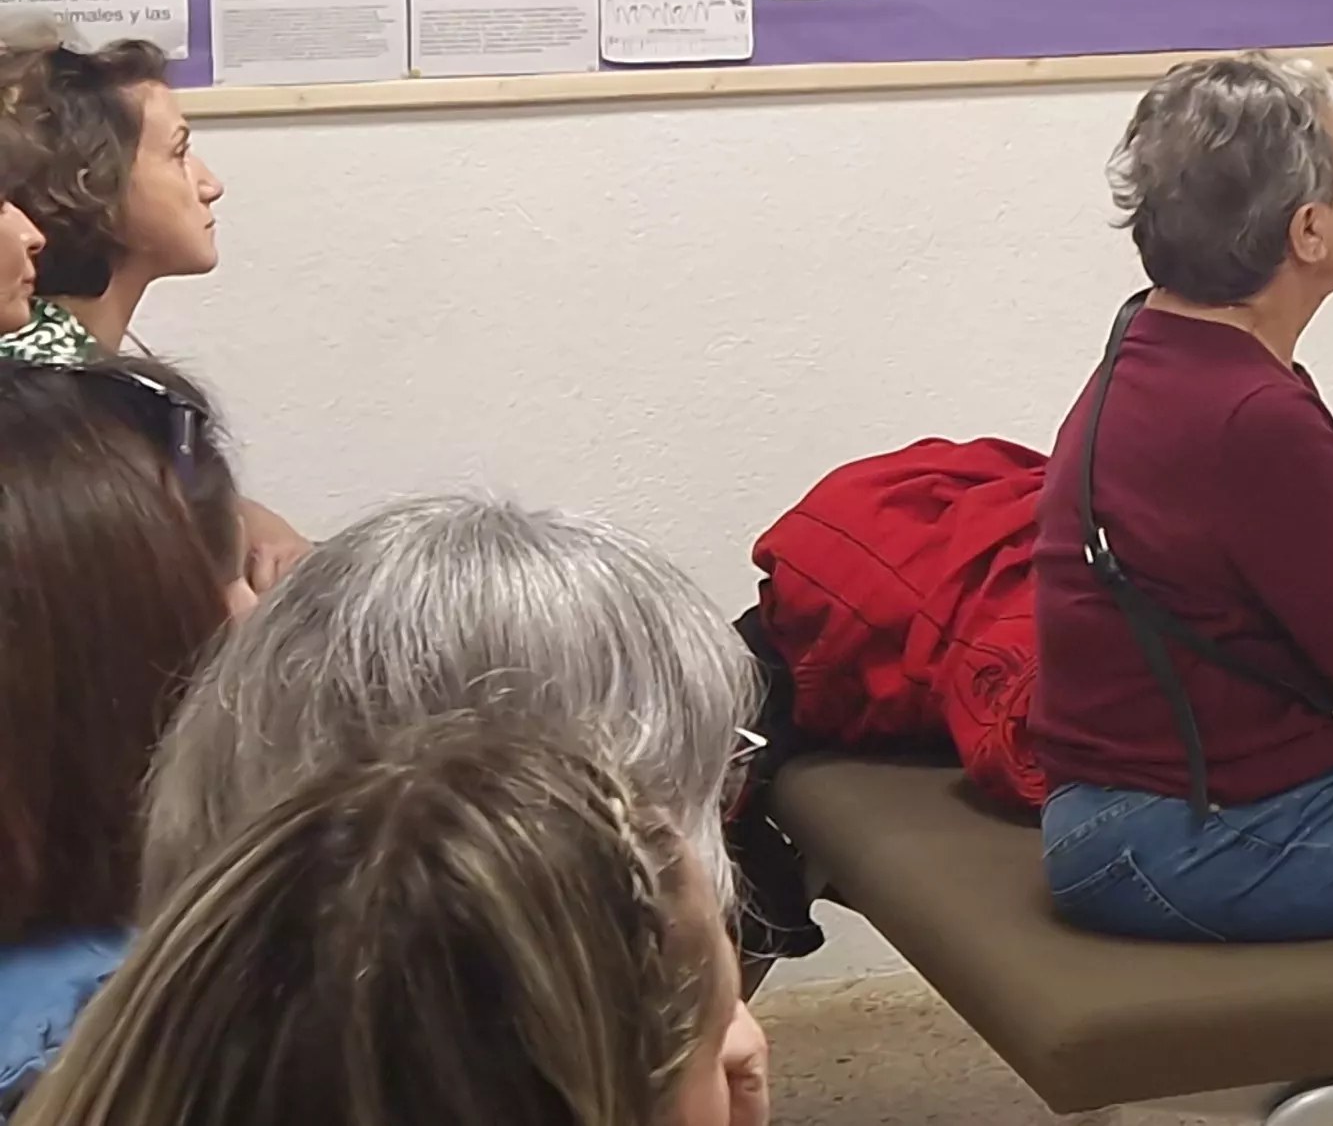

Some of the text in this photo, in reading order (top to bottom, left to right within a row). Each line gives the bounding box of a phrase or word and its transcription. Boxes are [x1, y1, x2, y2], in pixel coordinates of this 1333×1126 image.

[52, 7, 172, 24] nimales y las
